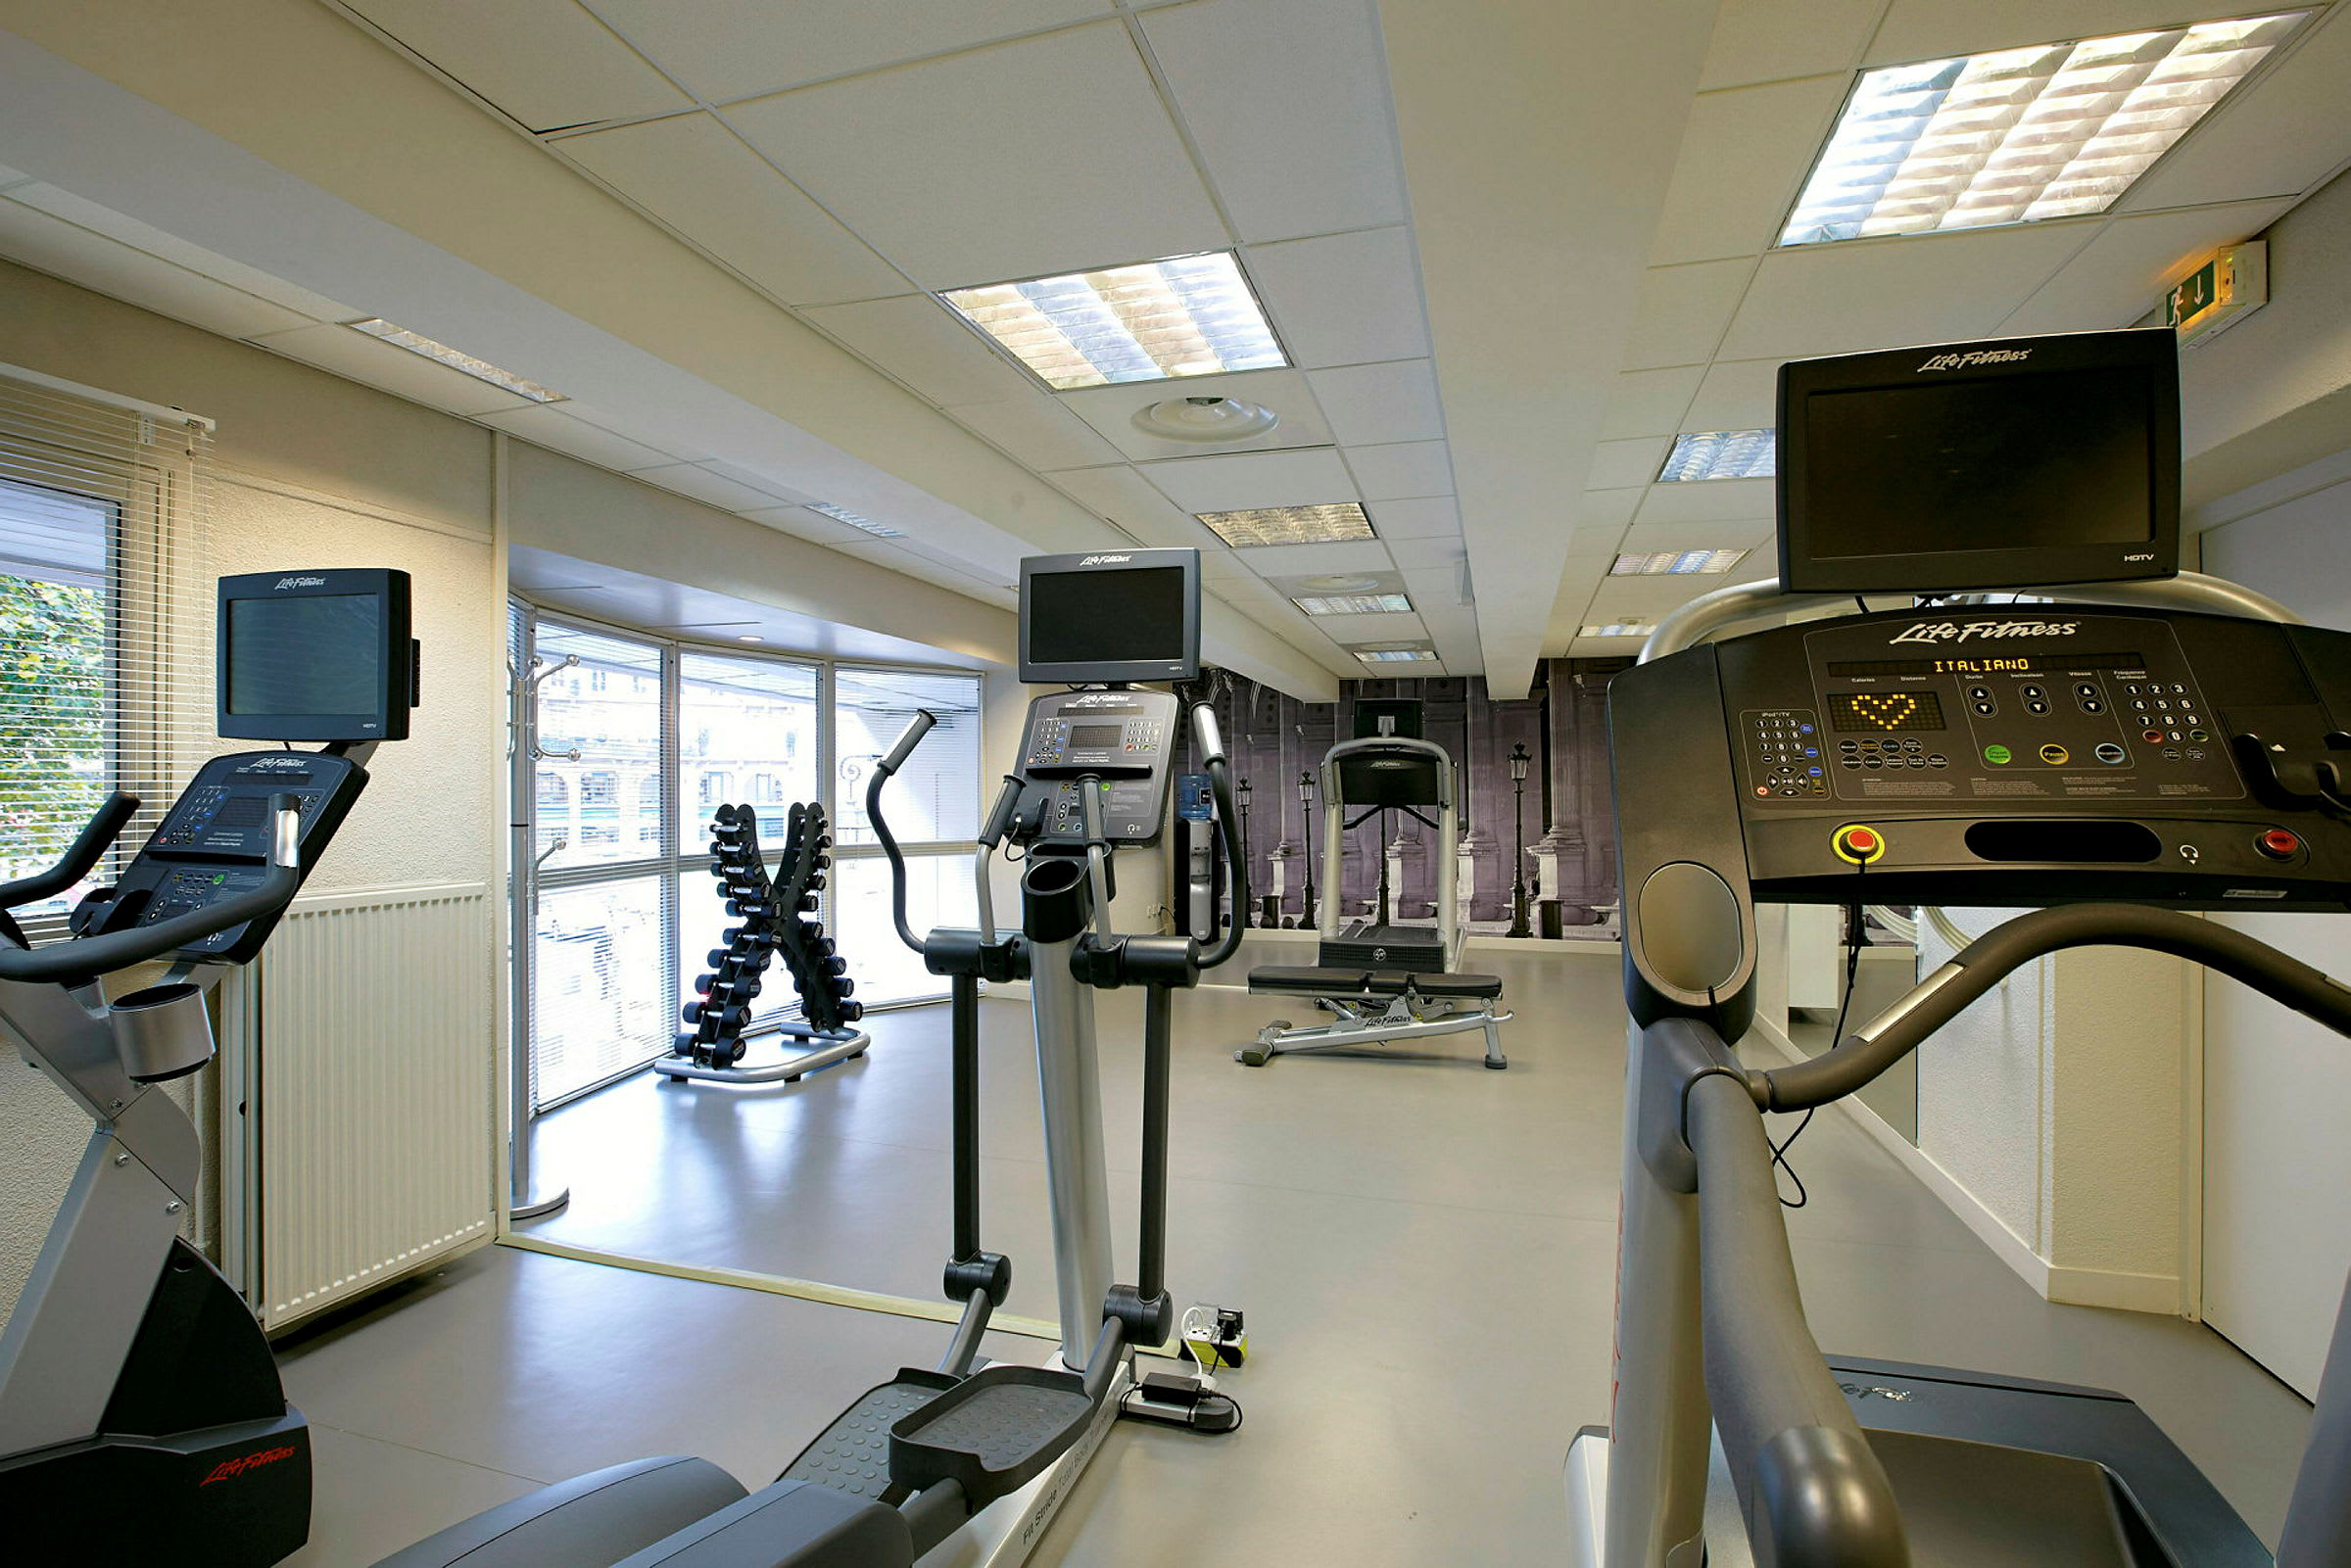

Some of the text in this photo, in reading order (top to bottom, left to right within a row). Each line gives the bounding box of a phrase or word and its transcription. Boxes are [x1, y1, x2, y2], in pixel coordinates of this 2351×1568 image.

[1917, 351, 2030, 372] Life Fitness
[2124, 553, 2155, 562] HDTV
[1889, 621, 2077, 644] Life Fitness
[1935, 658, 2029, 673] ITALIANO
[199, 1447, 296, 1486] Life Fitness
[1024, 1524, 1034, 1544] Fit
[1035, 1490, 1057, 1527] Stride
